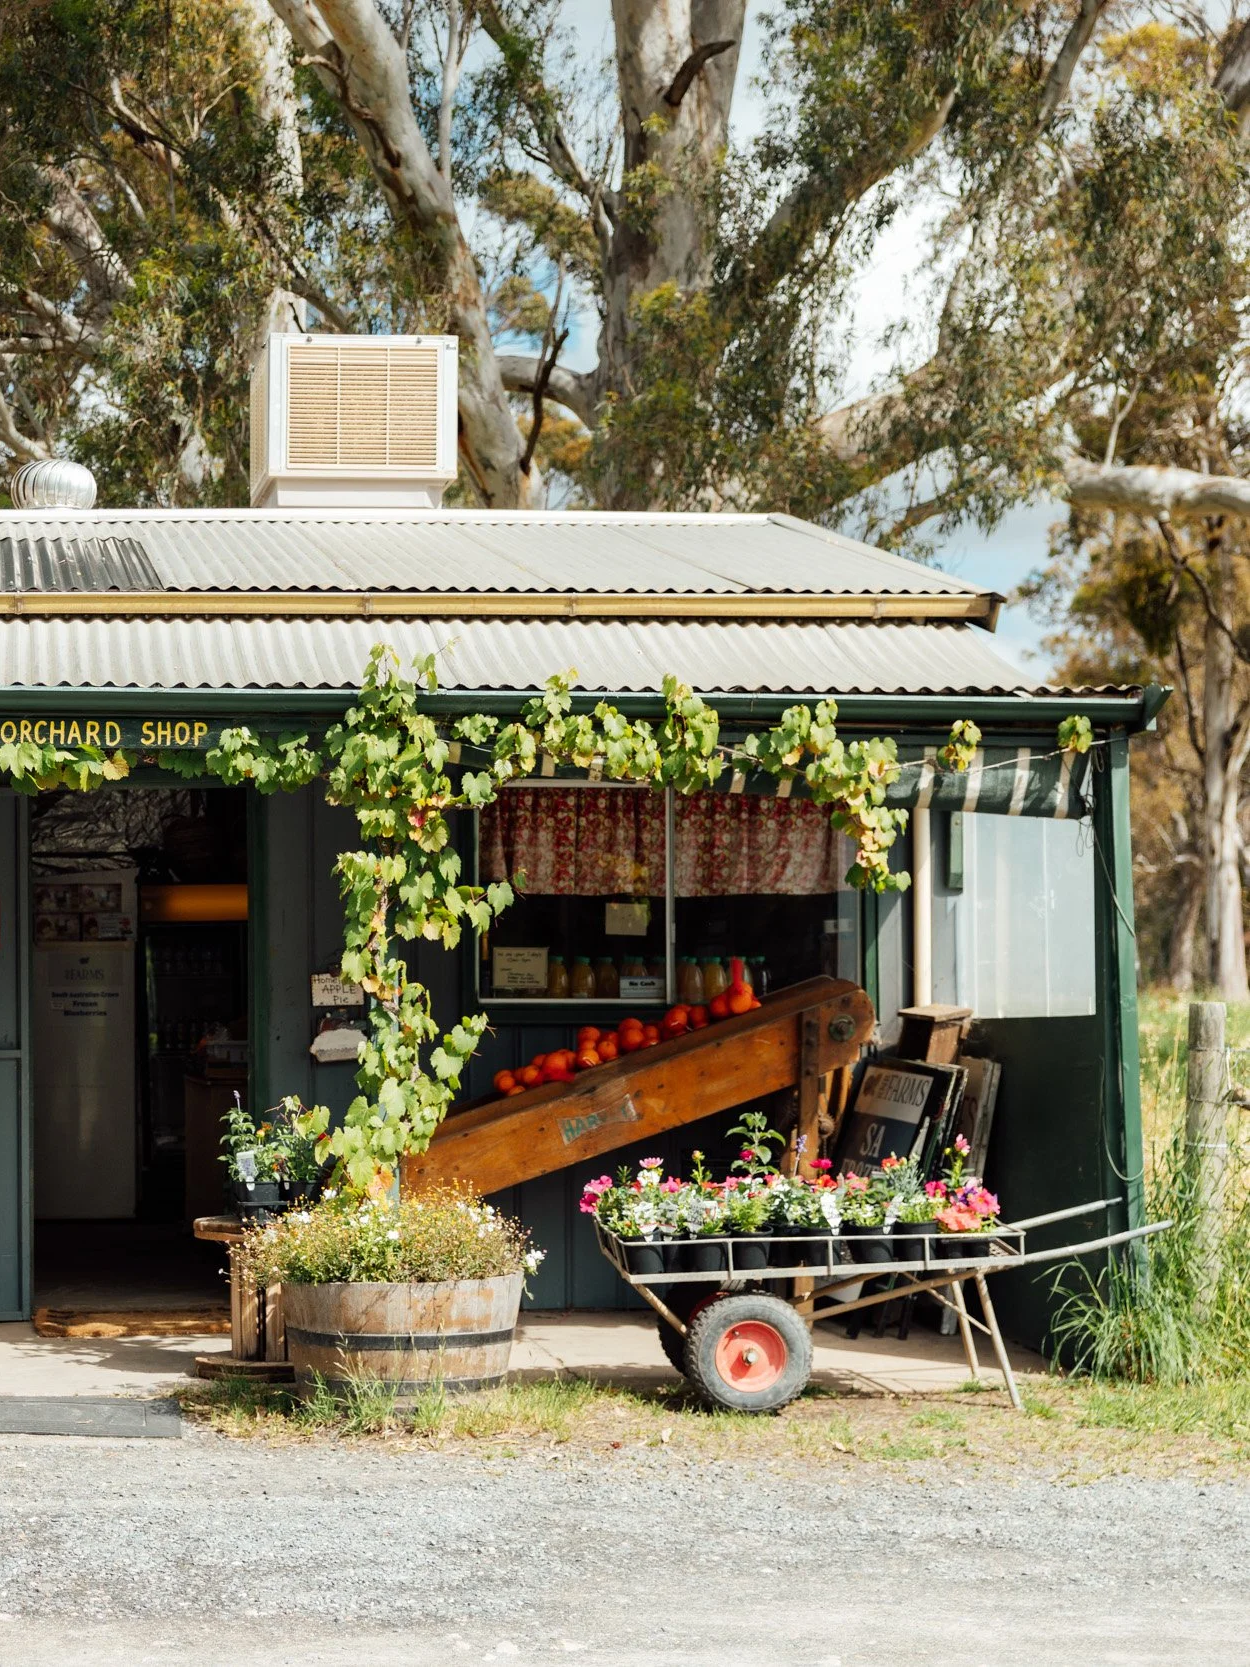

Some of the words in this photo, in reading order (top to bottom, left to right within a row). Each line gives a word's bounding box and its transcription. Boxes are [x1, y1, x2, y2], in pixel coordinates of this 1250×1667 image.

[0, 719, 121, 746] ORCHARD
[140, 721, 208, 746] SHOP
[321, 984, 357, 995] APPLE
[72, 1000, 98, 1008] Frozen
[333, 995, 349, 1005] Pie
[886, 1074, 930, 1108] FARMS
[859, 1123, 886, 1159] SA
